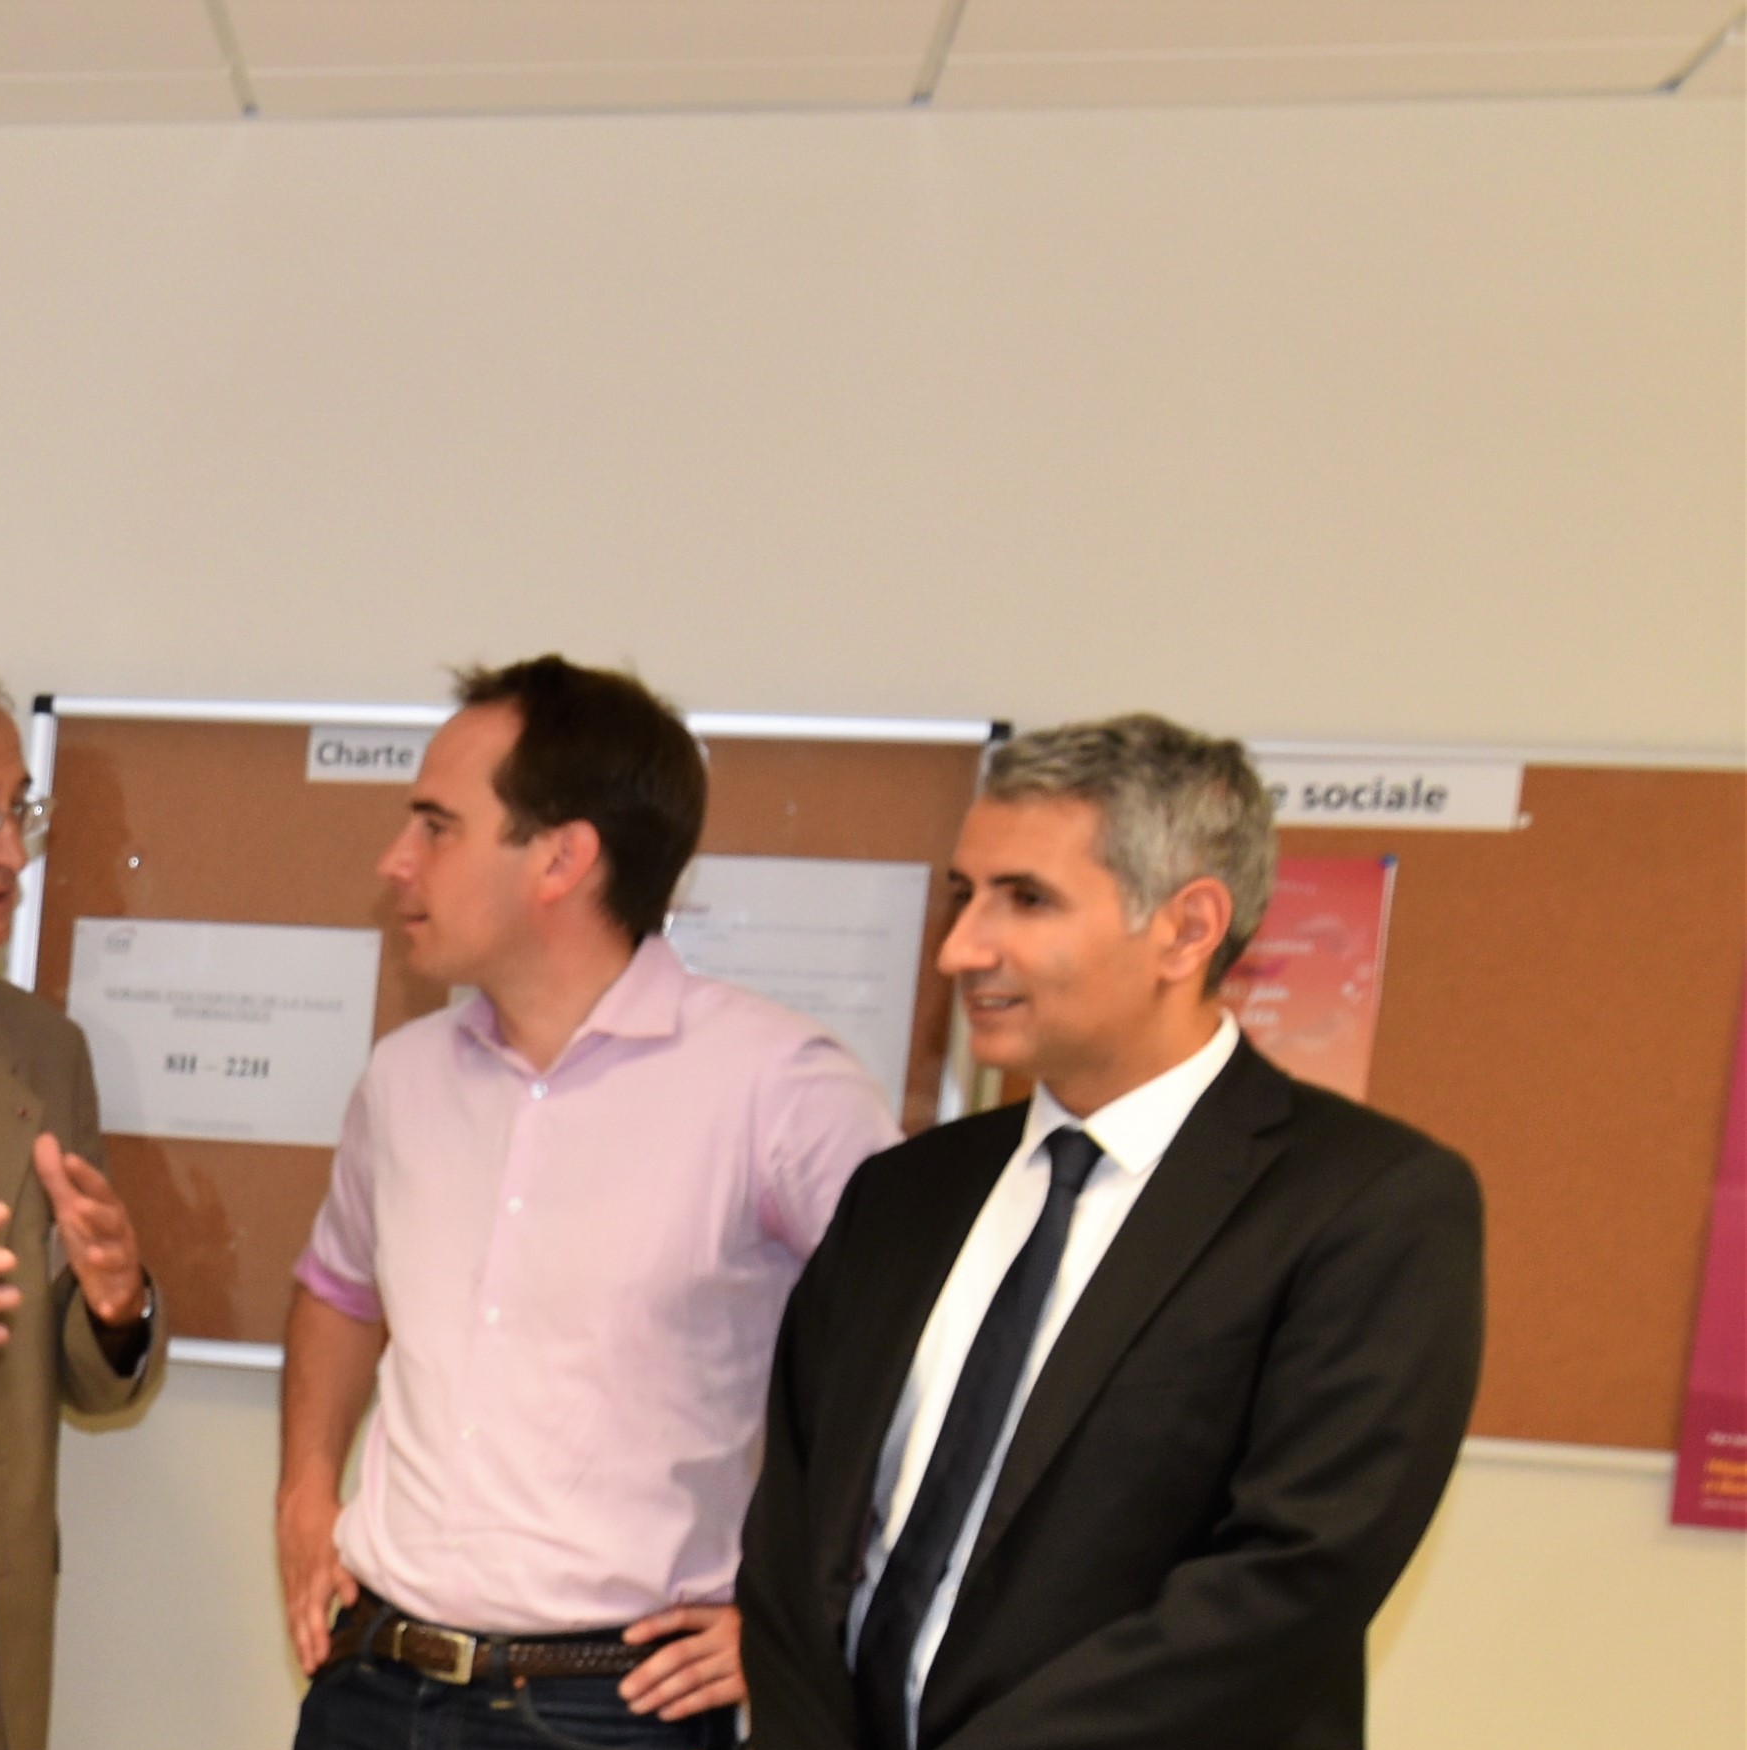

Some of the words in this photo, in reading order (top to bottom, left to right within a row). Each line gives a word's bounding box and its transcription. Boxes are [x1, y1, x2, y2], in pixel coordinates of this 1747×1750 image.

[316, 739, 413, 770] Charte
[1304, 776, 1449, 812] sociale
[224, 1056, 270, 1078] 22H
